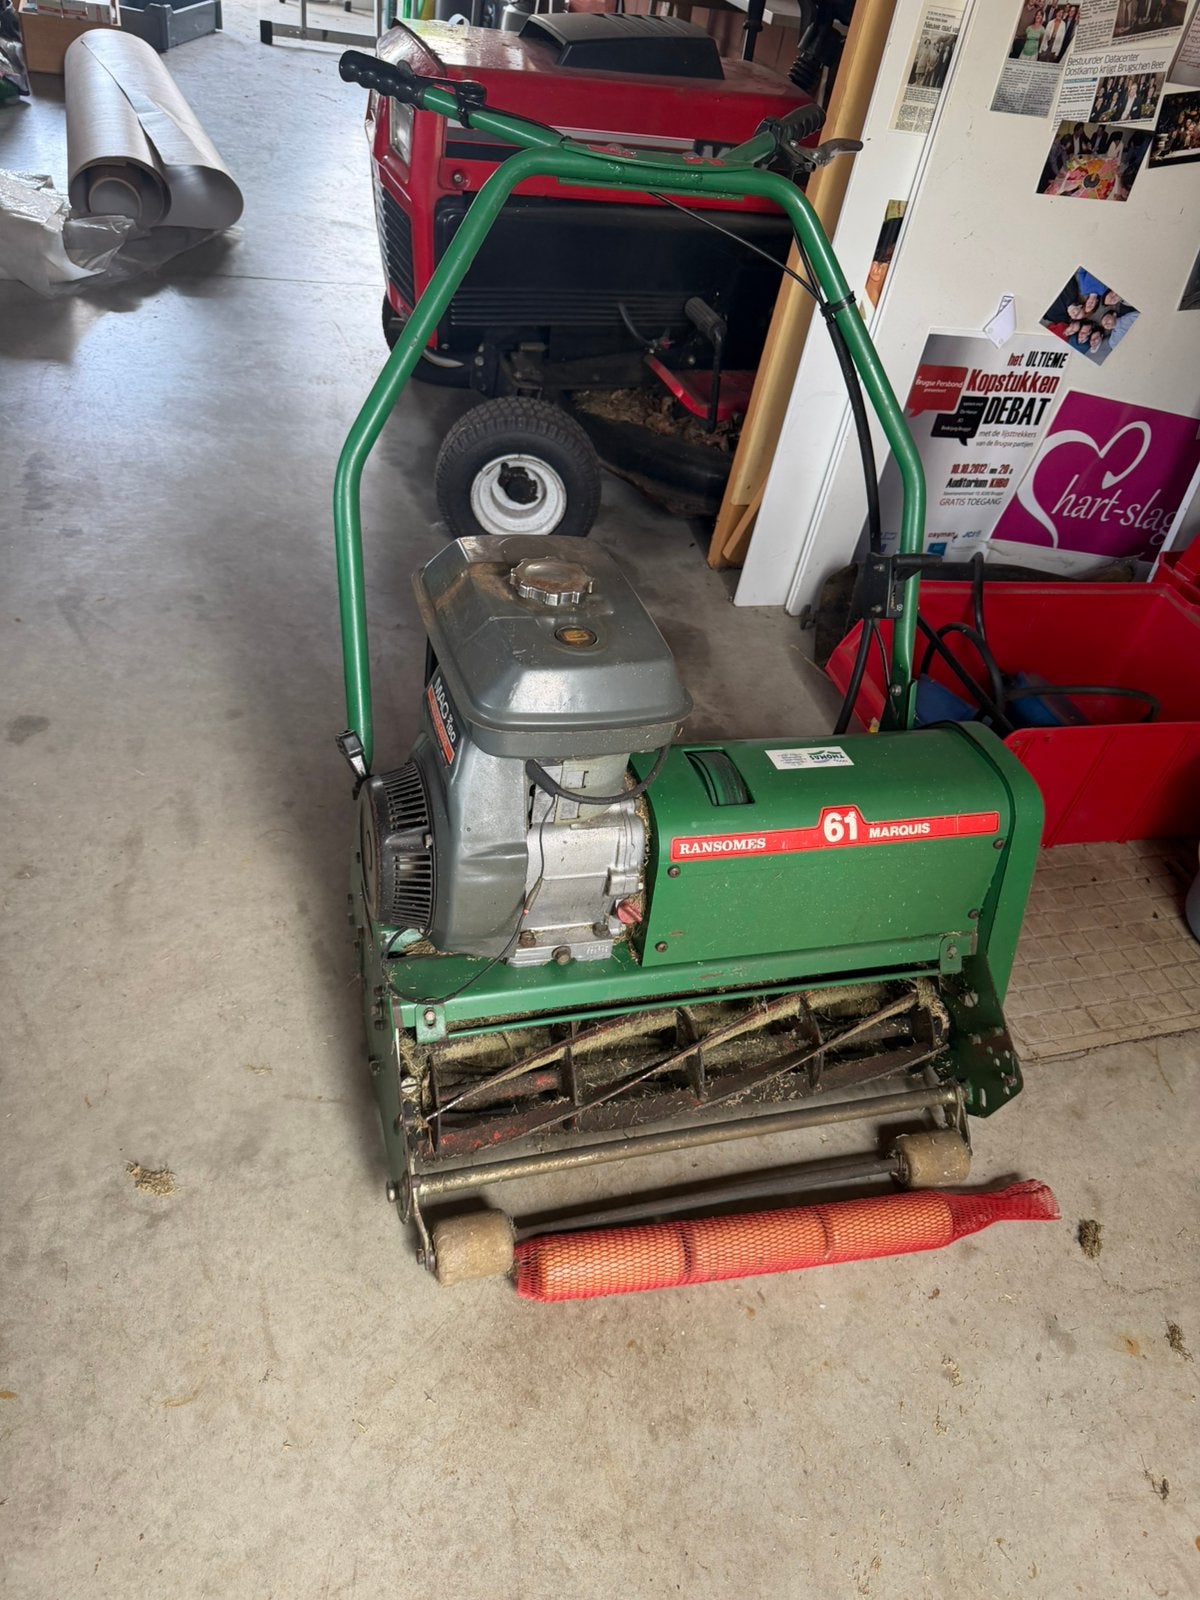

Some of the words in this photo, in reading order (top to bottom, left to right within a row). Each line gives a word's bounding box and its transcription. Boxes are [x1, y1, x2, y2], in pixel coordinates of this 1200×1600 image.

[1067, 56, 1104, 66] Bestuurder
[1104, 53, 1140, 64] Datacenter
[1065, 65, 1099, 76] Oostkamp
[1099, 65, 1116, 76] krijgt
[1117, 62, 1151, 74] Brugschen
[1151, 60, 1166, 69] Beer
[1007, 353, 1024, 367] het
[1025, 351, 1068, 368] ULTIEME
[915, 378, 936, 388] Brugse
[936, 379, 963, 389] Persbond
[967, 369, 1060, 395] Kopstukken
[983, 396, 1050, 426] DEBAT
[950, 463, 988, 475] 10.10.2012
[945, 477, 989, 488] Auditorium
[939, 497, 966, 506] GRATIS
[966, 497, 1002, 506] TOEGANG
[808, 753, 844, 761] THOMAS
[679, 838, 766, 855] RANSOMES
[823, 811, 858, 843] 61
[869, 822, 931, 839] MARQUIS
